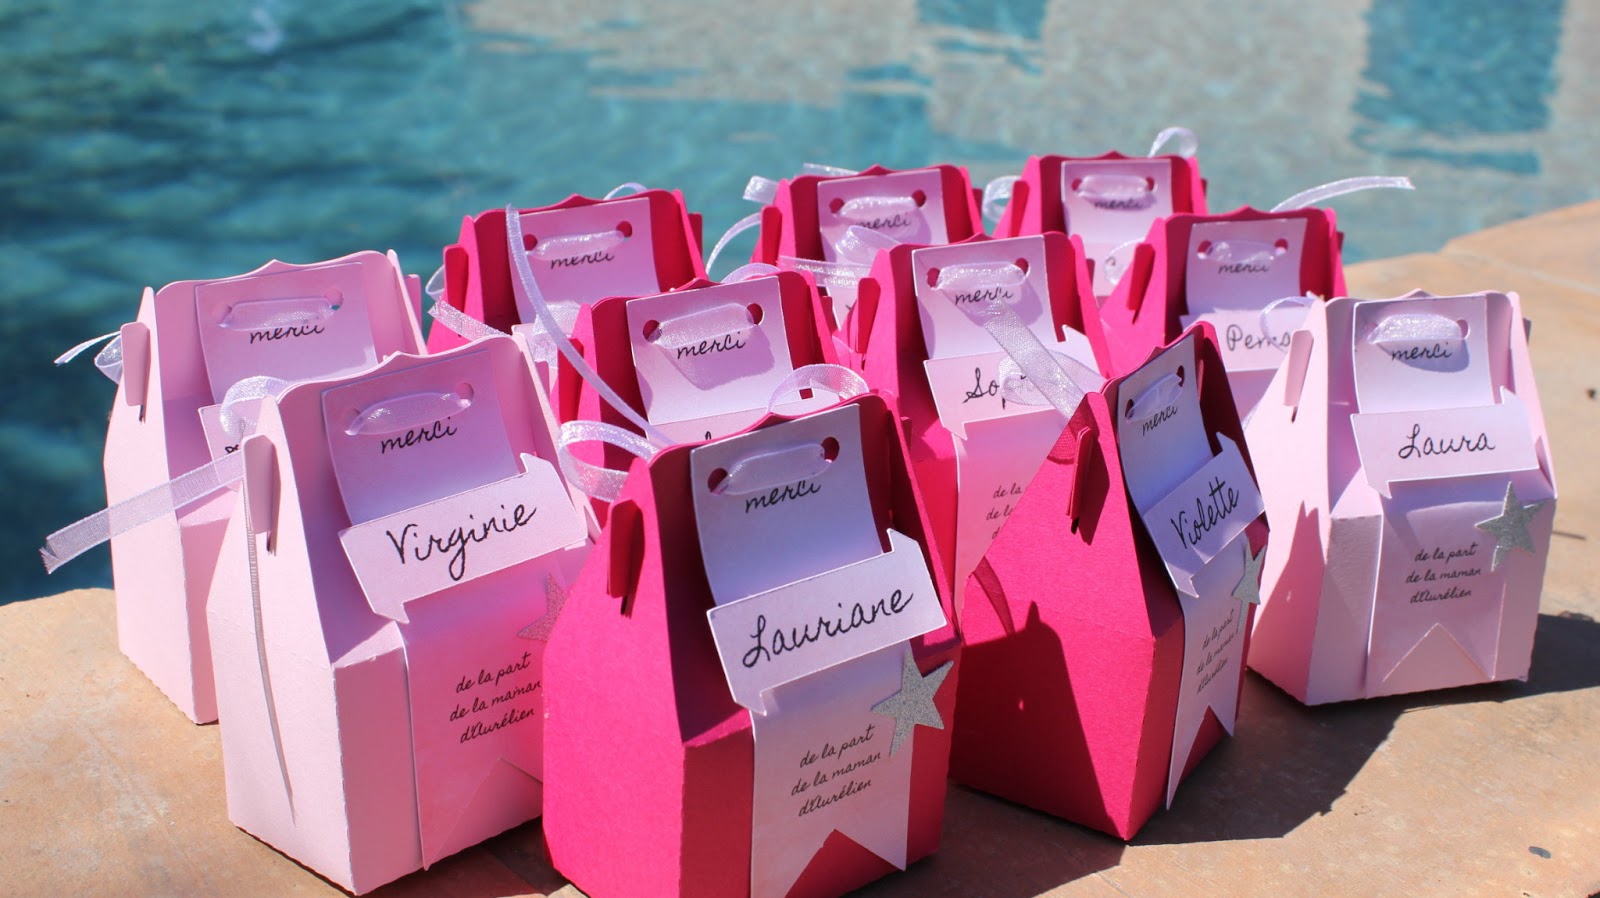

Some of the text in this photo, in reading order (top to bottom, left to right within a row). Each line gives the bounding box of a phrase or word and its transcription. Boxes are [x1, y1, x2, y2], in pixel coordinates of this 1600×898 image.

[857, 212, 912, 230] merci
[551, 251, 615, 270] merci
[1218, 262, 1270, 275] merci
[955, 286, 1014, 306] merci
[250, 324, 325, 344] merci
[677, 331, 746, 360] merci
[1391, 342, 1453, 361] merci
[381, 416, 458, 454] merci
[1142, 405, 1179, 437] merci
[1398, 423, 1496, 459] Laura
[745, 480, 821, 514] merci
[993, 482, 1023, 499] de la
[986, 506, 1002, 521] de
[1170, 476, 1240, 550] Violette
[386, 503, 537, 582] Virginie
[1414, 542, 1478, 564] de la part
[1405, 568, 1481, 583] de la maman
[742, 589, 914, 668] Lauriane
[456, 651, 532, 693] de la part
[450, 680, 542, 722] de la maman
[800, 724, 876, 768] de la part
[791, 752, 882, 796] de la maman
